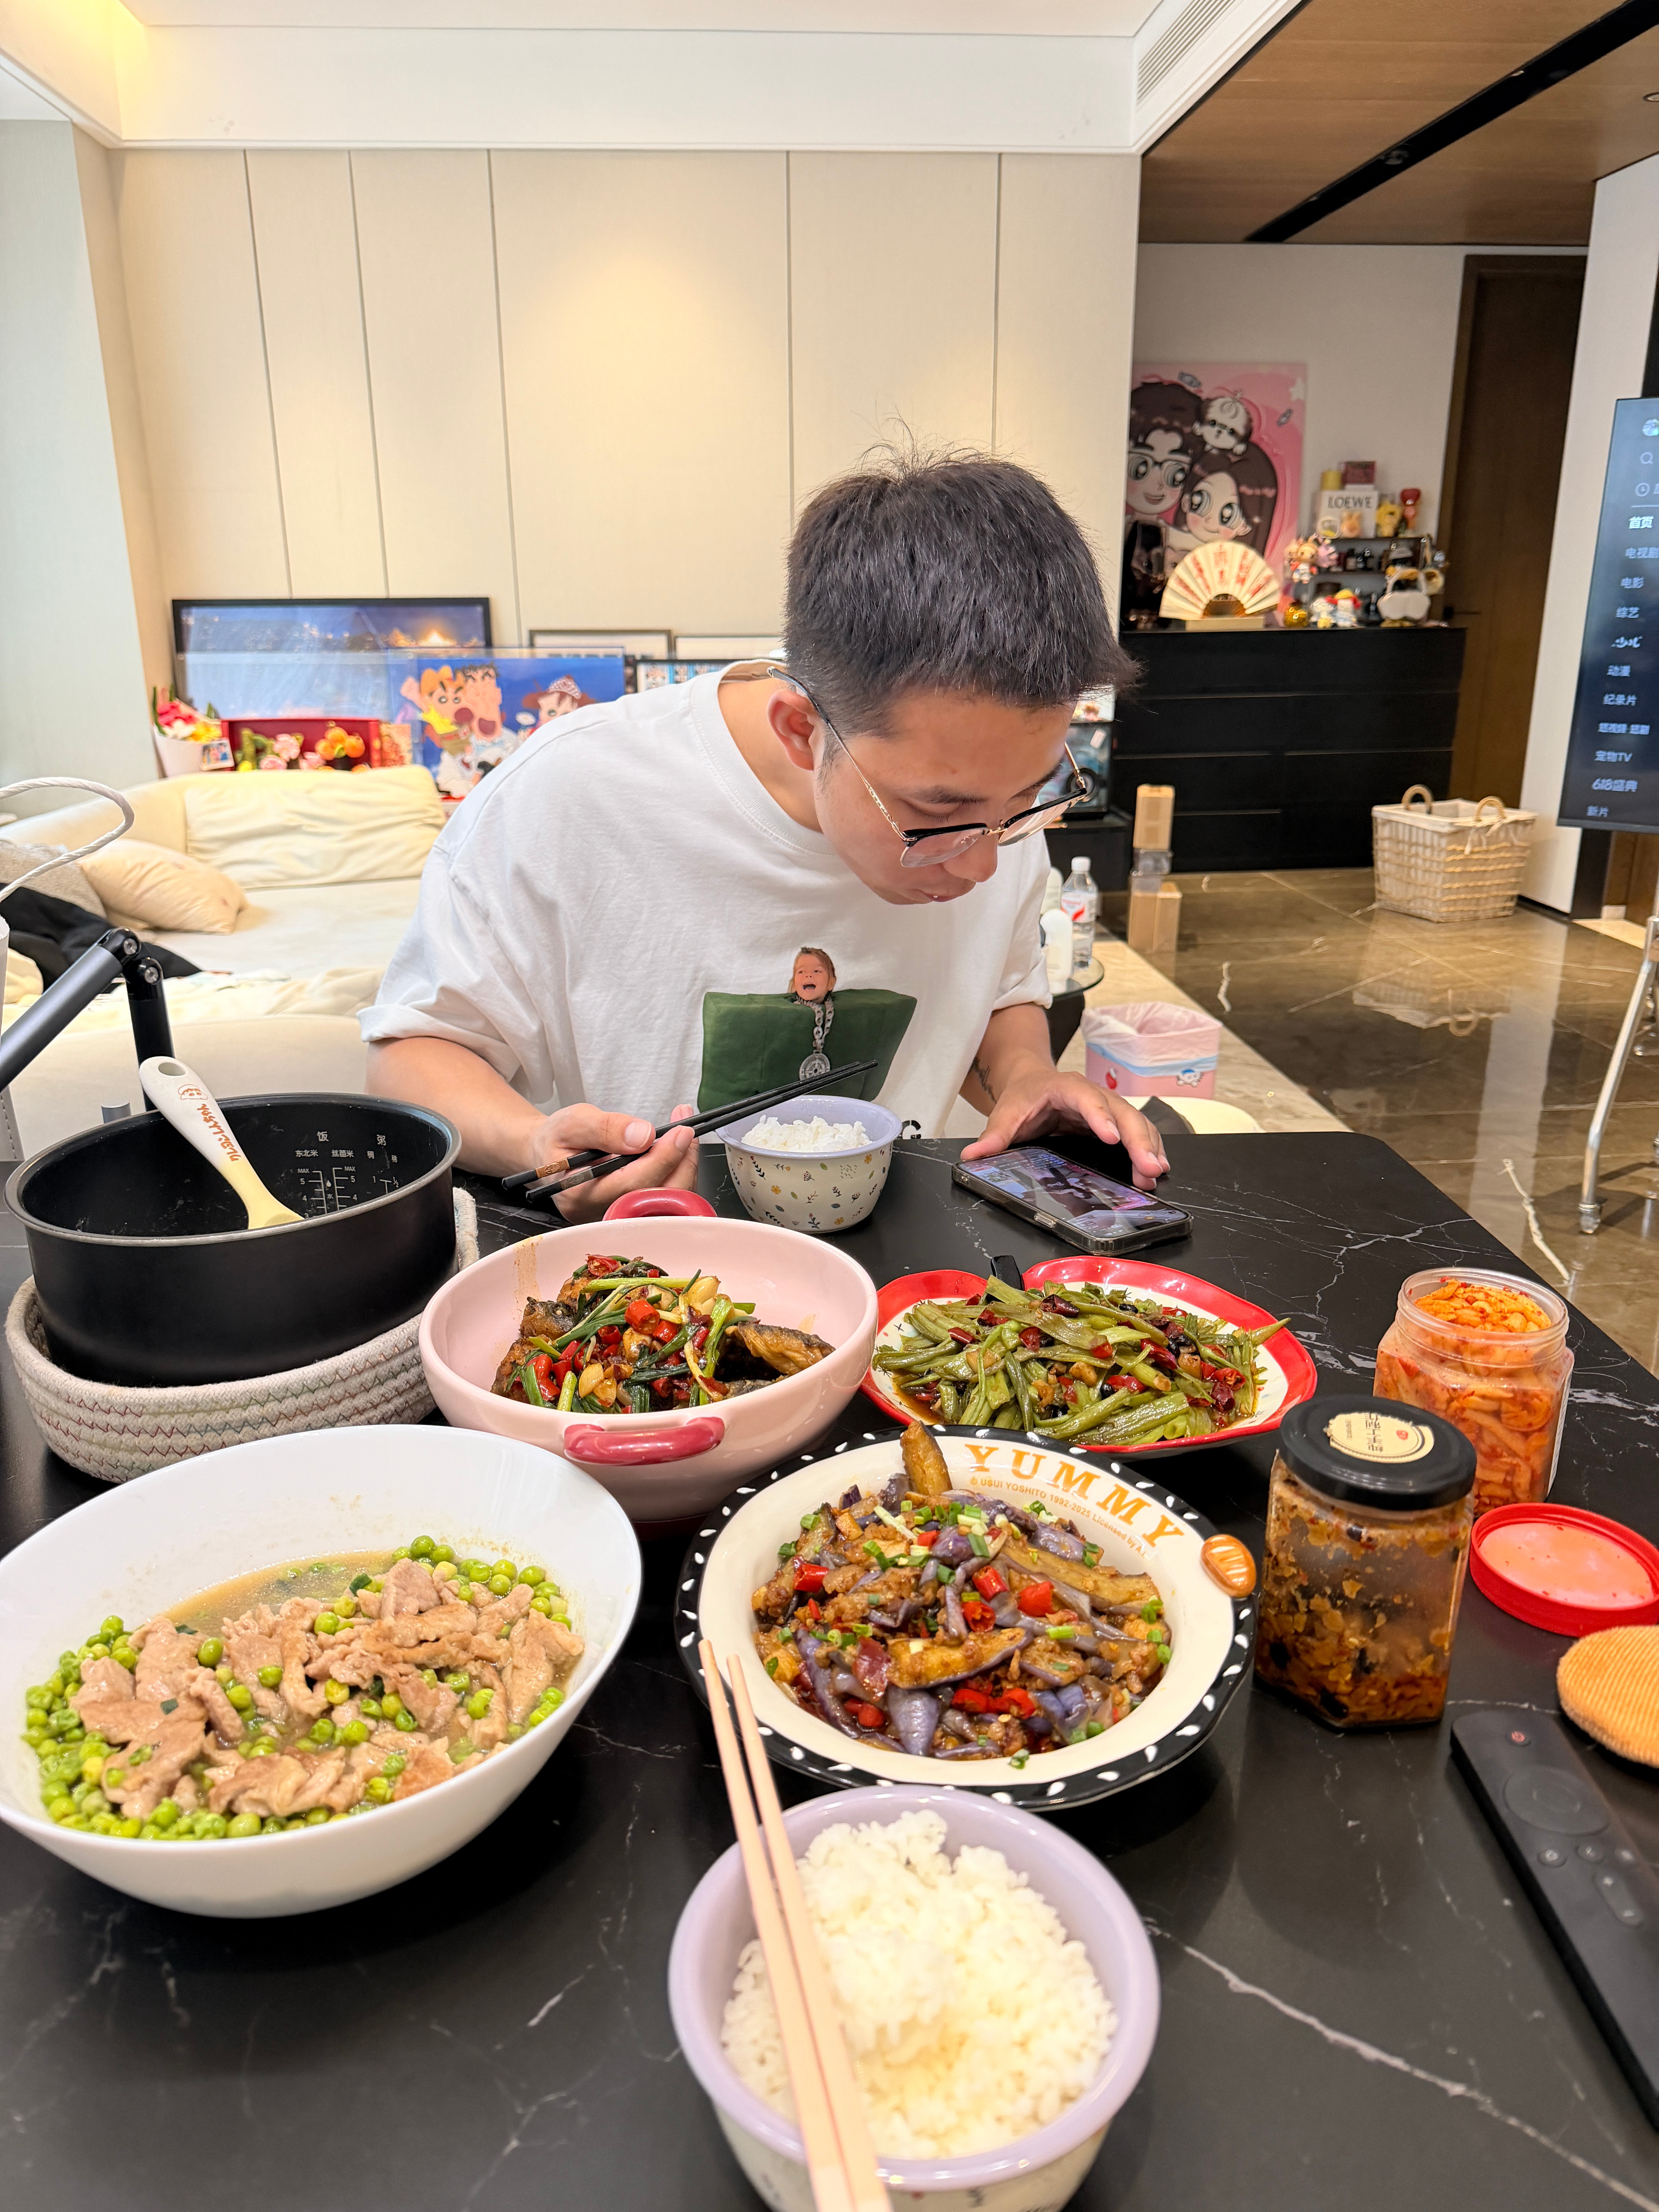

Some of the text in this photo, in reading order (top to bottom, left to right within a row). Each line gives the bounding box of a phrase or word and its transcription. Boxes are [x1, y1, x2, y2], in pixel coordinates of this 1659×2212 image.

[1629, 516, 1654, 529] 首页
[1621, 577, 1644, 589] 电影
[1616, 607, 1640, 618] 综艺
[197, 1104, 241, 1161] クレヨンしんちゃん
[317, 1131, 329, 1142] 饭
[377, 1135, 386, 1146] 粥
[331, 1149, 354, 1158] 丝苗米
[1328, 1270, 1373, 1283] LOEWE
[965, 1444, 1184, 1547] YUMMY
[1006, 1482, 1047, 1499] YOSHITO
[1092, 1514, 1127, 1540] Licensed
[1127, 1536, 1136, 1548] by
